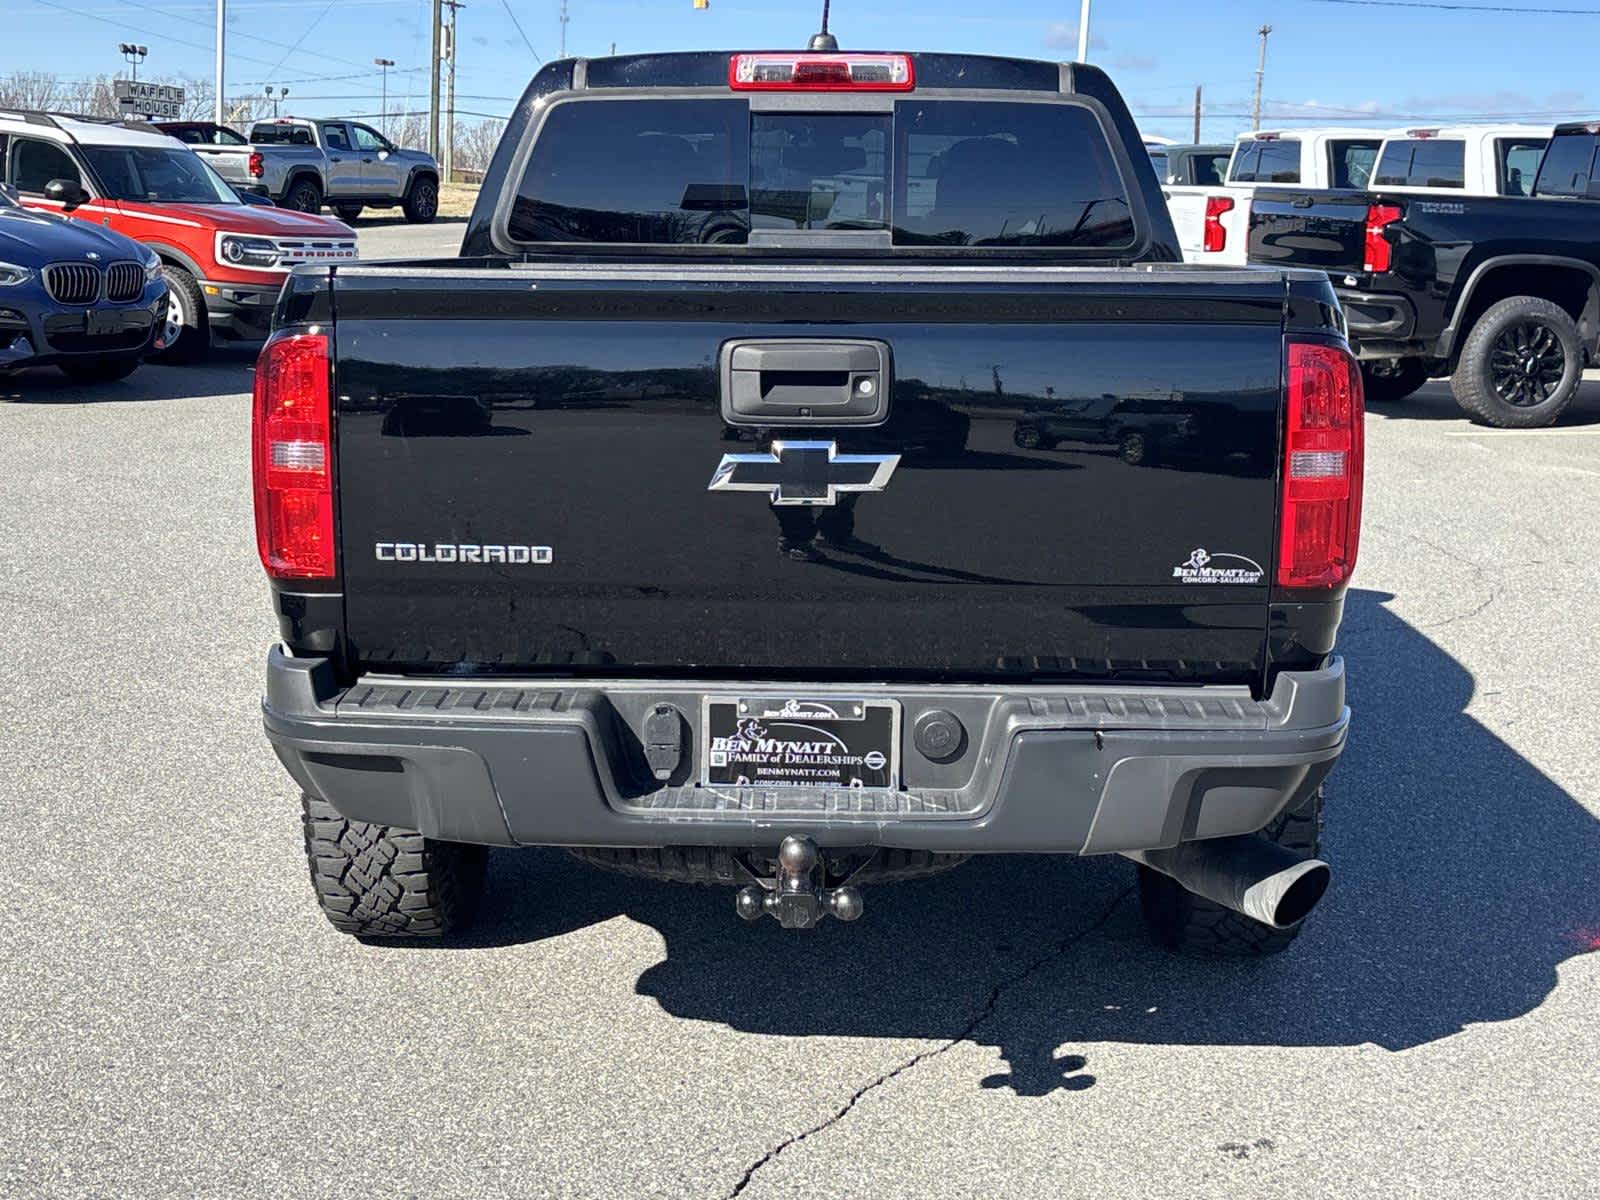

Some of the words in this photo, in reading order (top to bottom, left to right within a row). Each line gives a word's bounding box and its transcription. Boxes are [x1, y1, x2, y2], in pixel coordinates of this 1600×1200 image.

[130, 85, 182, 100] WAFFLE
[135, 100, 178, 115] HOUSE
[376, 543, 553, 564] COLORADO
[1172, 567, 1199, 577] BEN
[711, 737, 751, 752] BEN
[754, 738, 836, 754] MYNATT
[727, 751, 769, 762] FAMILY
[770, 753, 780, 763] of
[785, 752, 863, 766] DEALERSHIPS
[757, 767, 840, 776] BENMYNATT.COM
